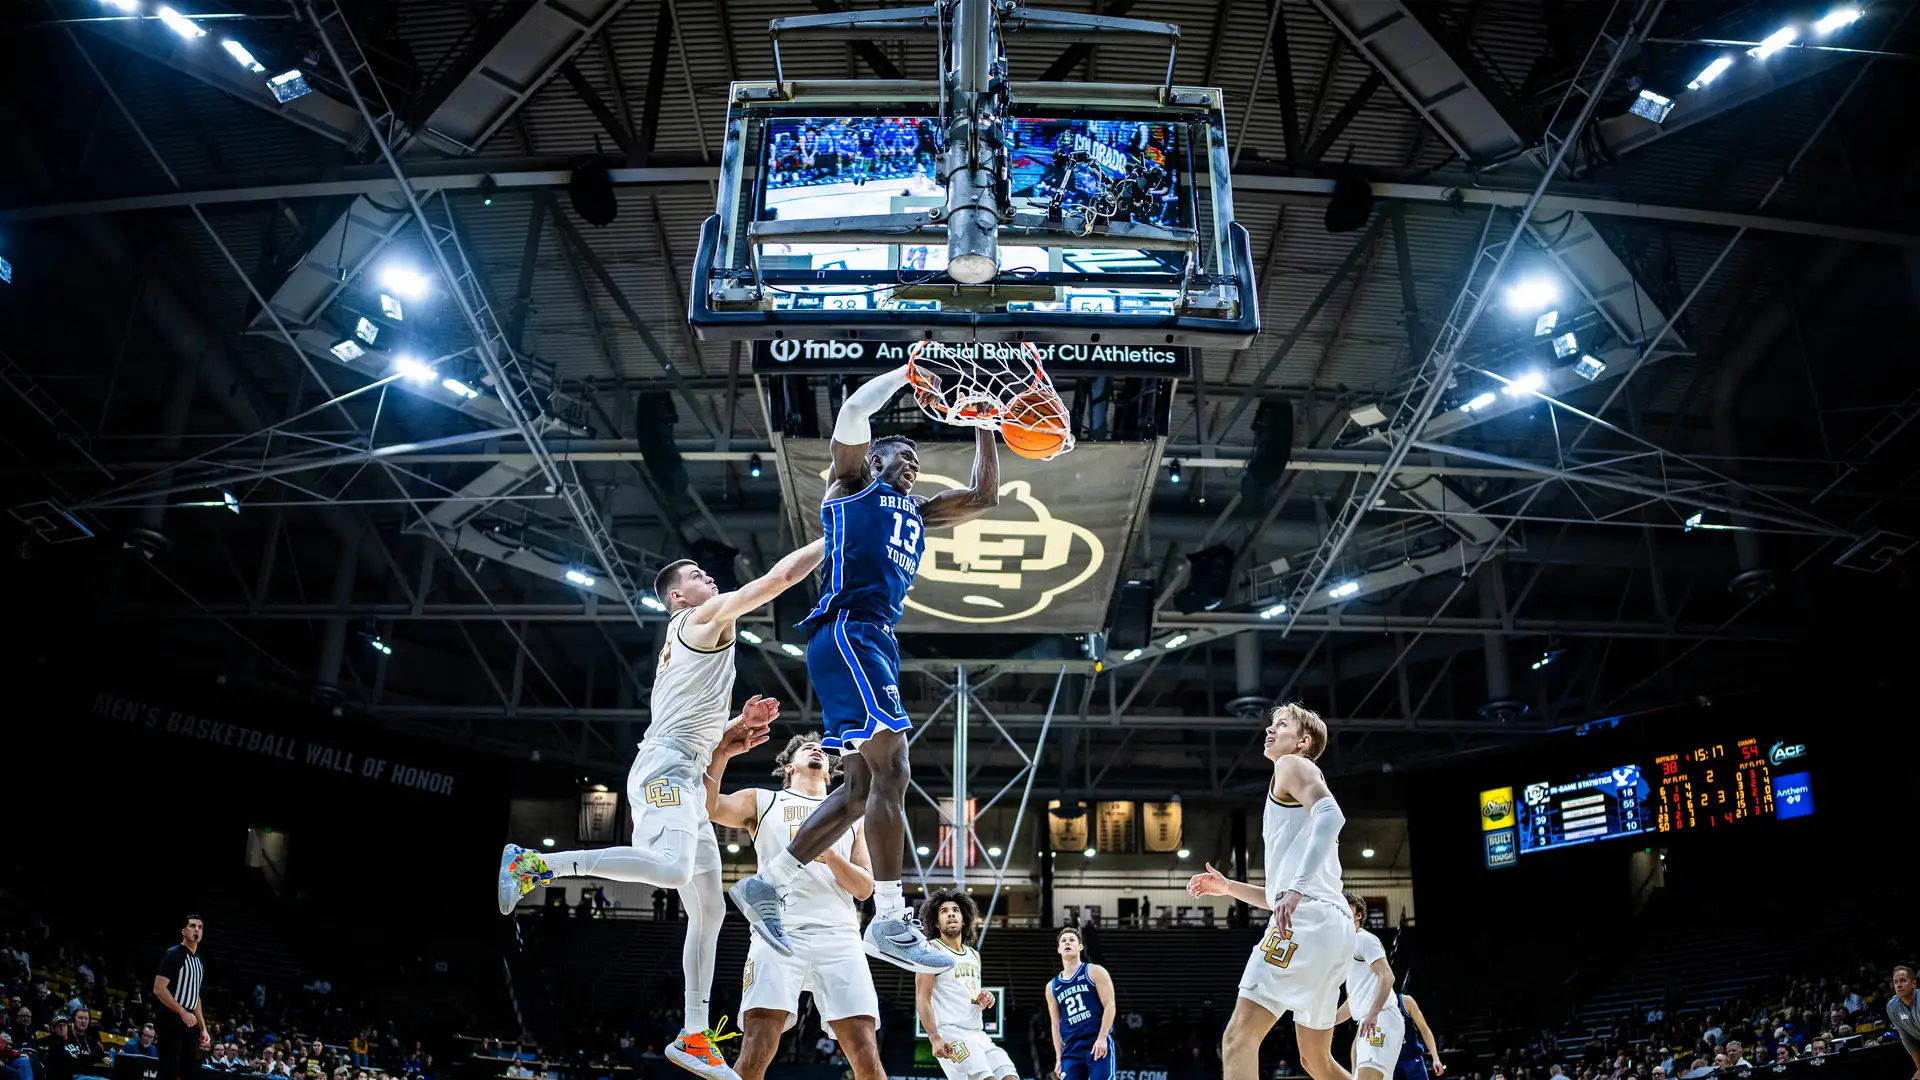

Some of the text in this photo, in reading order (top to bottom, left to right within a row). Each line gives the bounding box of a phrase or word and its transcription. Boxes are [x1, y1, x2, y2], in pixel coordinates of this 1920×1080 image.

[804, 340, 864, 359] fnbo
[876, 342, 904, 359] An
[908, 340, 979, 360] Official
[983, 342, 1034, 361] Bank
[1040, 344, 1054, 361] of
[1058, 344, 1088, 362] CU
[1091, 345, 1176, 363] Athletics
[880, 495, 924, 526] BRIGH
[890, 512, 921, 555] 13
[886, 545, 917, 576] YOUNG
[91, 691, 454, 796] MEN'S BASKETBALL WALL OF HONOR
[1694, 745, 1724, 761] 15:17
[1741, 745, 1759, 760] 54
[1662, 761, 1678, 776] 38
[1706, 769, 1713, 783] 2
[1577, 776, 1613, 790] STATISTICS
[644, 778, 681, 808] CU
[1700, 792, 1708, 807] 2
[1717, 789, 1726, 804] 3
[1776, 786, 1809, 798] Anthem
[1483, 800, 1511, 816] Starry
[1535, 804, 1546, 815] 17
[1735, 808, 1748, 819] 21
[1724, 811, 1733, 824] 4
[1625, 820, 1638, 831] 10
[1489, 832, 1512, 846] BUILT
[1490, 851, 1514, 864] TOUGH
[1056, 984, 1090, 1004] BRIGHAM
[1064, 993, 1087, 1016] 21
[1067, 1010, 1092, 1026] YOUNG
